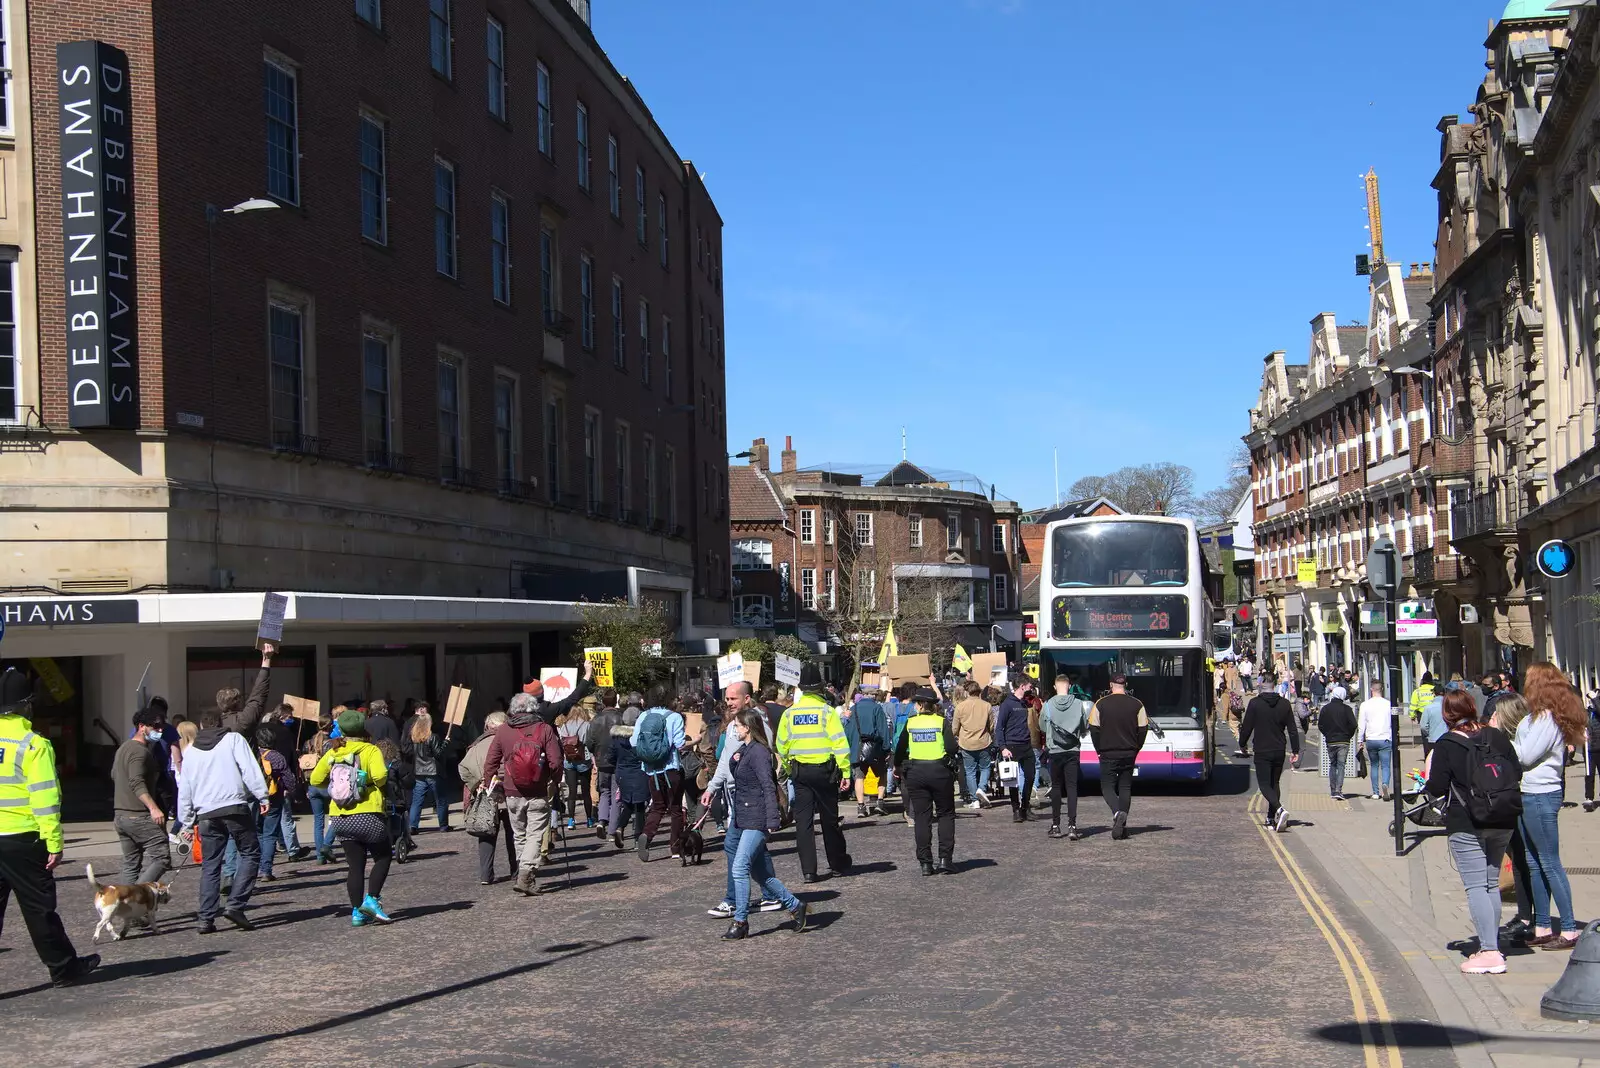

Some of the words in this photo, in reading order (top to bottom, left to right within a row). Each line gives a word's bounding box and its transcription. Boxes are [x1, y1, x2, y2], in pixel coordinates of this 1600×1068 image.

[63, 64, 101, 407] DEBENHAMS
[102, 62, 132, 403] DEBENHAMS
[5, 603, 94, 622] HAMS
[1149, 612, 1169, 630] 28
[589, 653, 609, 661] KILL
[590, 661, 606, 669] THE
[592, 668, 609, 677] ILL
[794, 714, 818, 725] POLICE
[913, 732, 936, 741] POLICE
